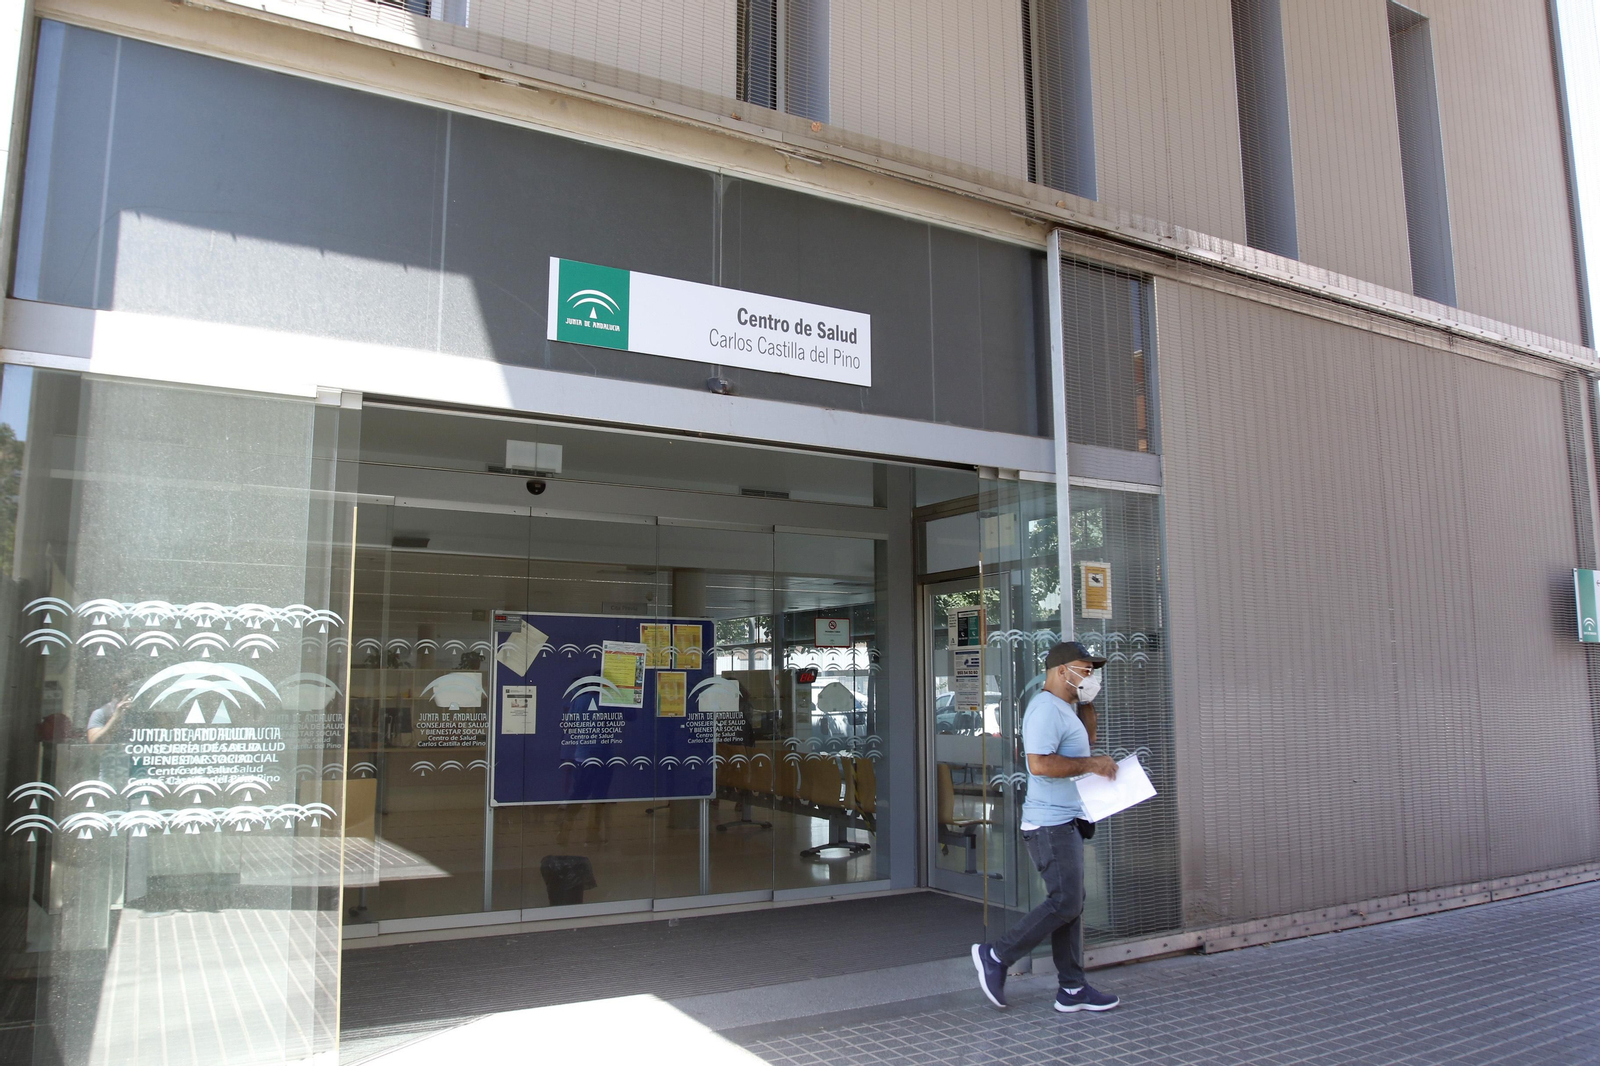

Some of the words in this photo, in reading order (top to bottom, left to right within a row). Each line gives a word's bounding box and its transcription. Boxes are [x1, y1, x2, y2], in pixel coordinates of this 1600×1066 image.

[565, 317, 582, 326] JUNTA
[592, 321, 620, 332] ANDALUCIA
[737, 307, 790, 333] Centro
[794, 318, 812, 337] de
[817, 321, 857, 345] Salud
[709, 328, 753, 352] Carlos
[757, 336, 805, 361] Castilla
[809, 345, 829, 364] del
[832, 348, 860, 370] Pino
[418, 713, 439, 721] JUNTA
[442, 713, 450, 721] DE
[453, 712, 487, 721] ANDALUCIA
[561, 713, 580, 721] JUNTA
[582, 713, 590, 721] DE
[592, 713, 623, 721] ANDALUCIA
[687, 713, 705, 721] JUNTA
[715, 712, 744, 720] ANDALUCIA
[416, 721, 456, 729] CONSEJERÍA
[132, 755, 141, 766] Y
